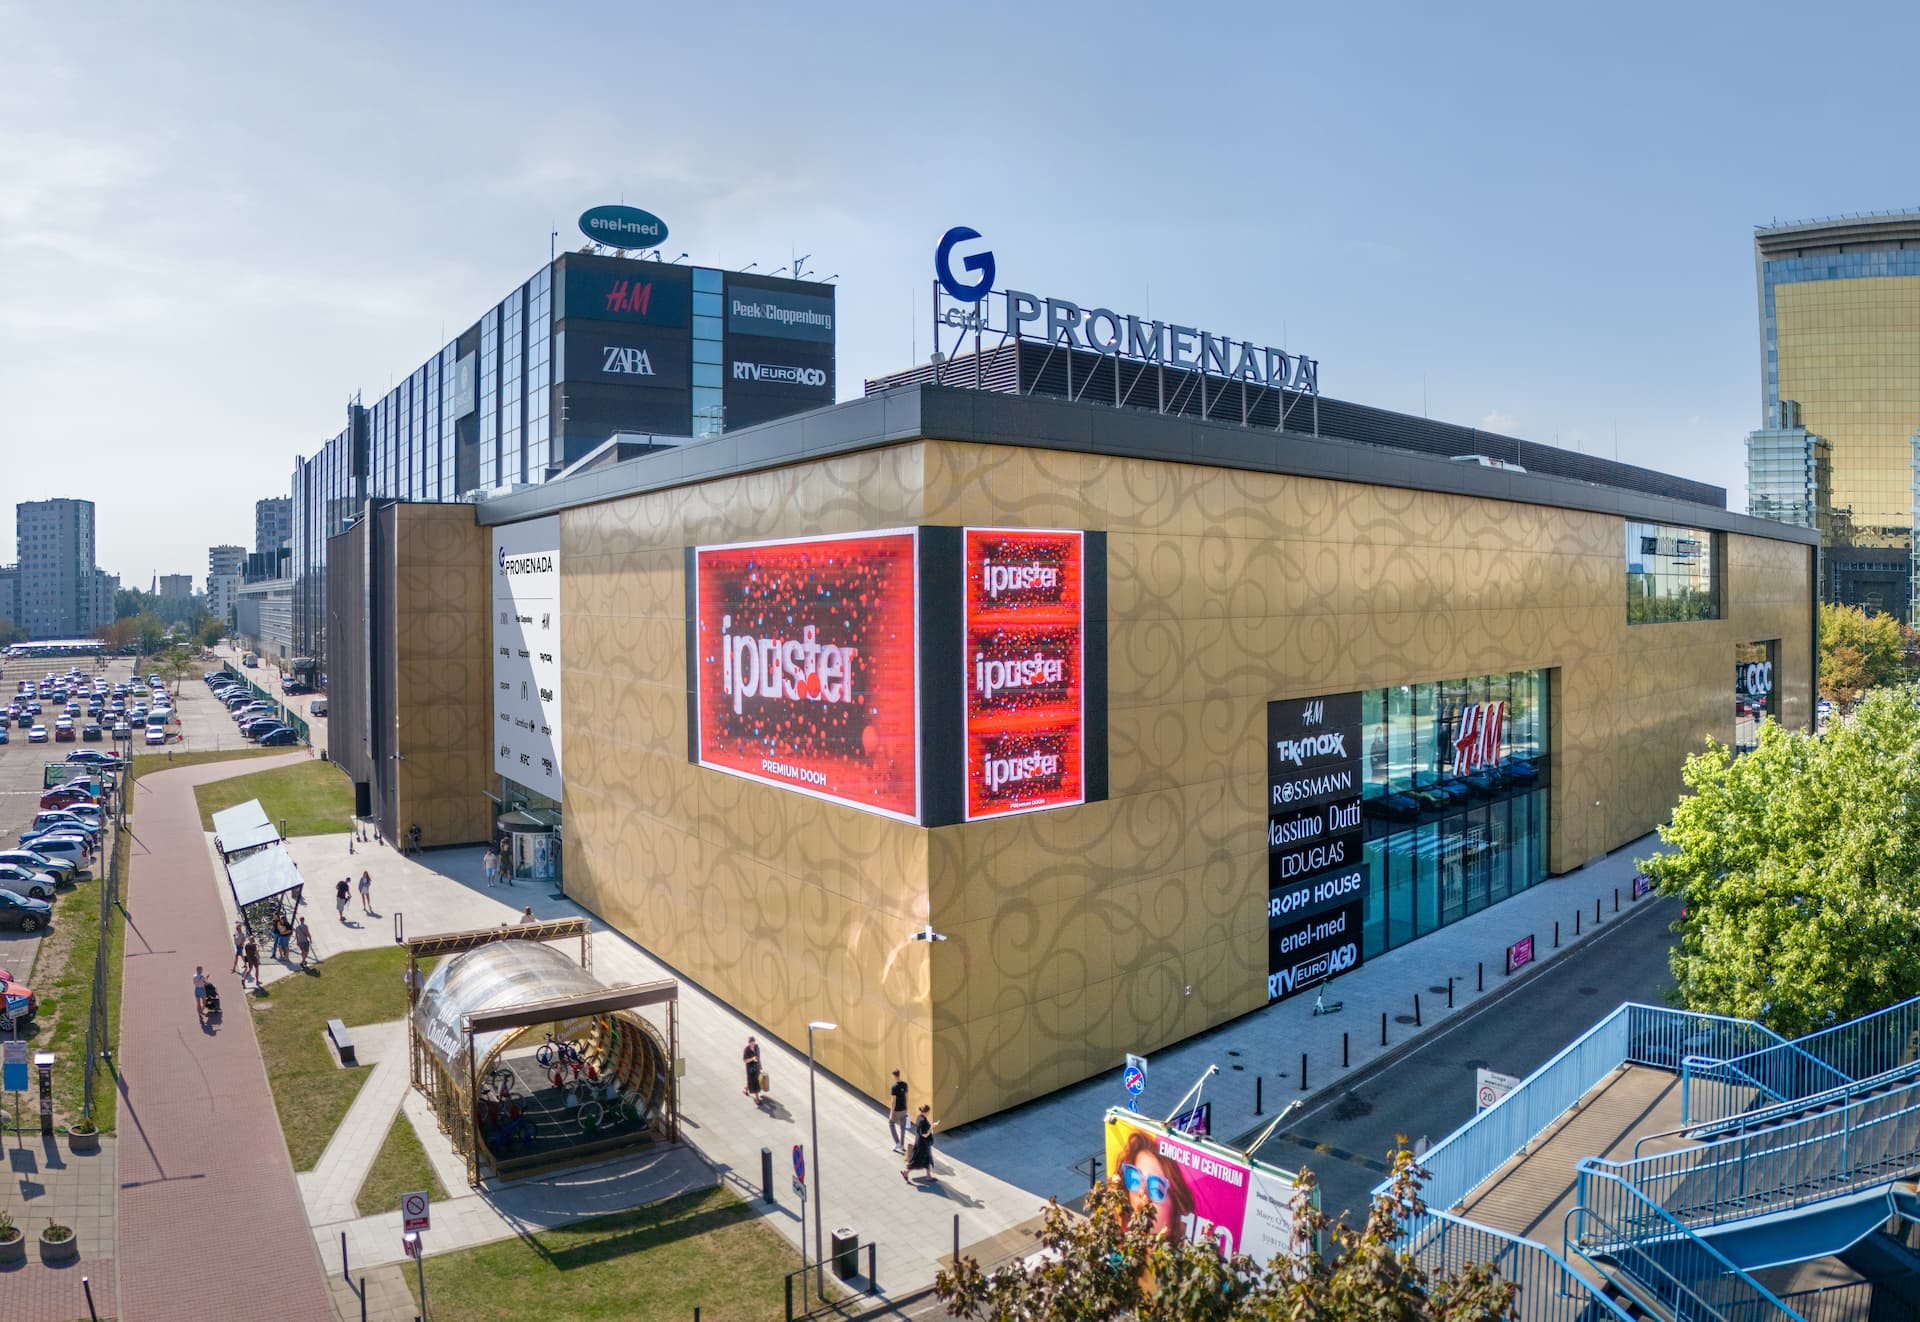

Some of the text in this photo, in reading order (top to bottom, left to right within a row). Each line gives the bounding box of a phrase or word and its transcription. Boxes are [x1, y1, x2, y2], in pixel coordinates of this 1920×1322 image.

[590, 217, 659, 236] enel-med
[606, 280, 652, 315] H&M
[944, 307, 987, 335] City
[1006, 289, 1319, 394] PROMENADA
[602, 346, 656, 376] ZARA
[505, 556, 553, 576] PROMENADA
[1747, 661, 1773, 695] CCC
[1302, 700, 1324, 727] H&M
[1453, 701, 1505, 777] H&M
[762, 759, 827, 786] PREMIUM DOOH
[1273, 771, 1352, 804] ROSSMANN
[1329, 800, 1360, 831] Dutti
[1281, 841, 1345, 879] DOUGLAS
[1268, 888, 1310, 917] ROPP
[1280, 911, 1346, 953] enel-med
[1267, 943, 1357, 1000] RTV EURO AGD
[1483, 1091, 1493, 1102] 20
[1159, 1141, 1243, 1187] EMOCJE W CENTRUM
